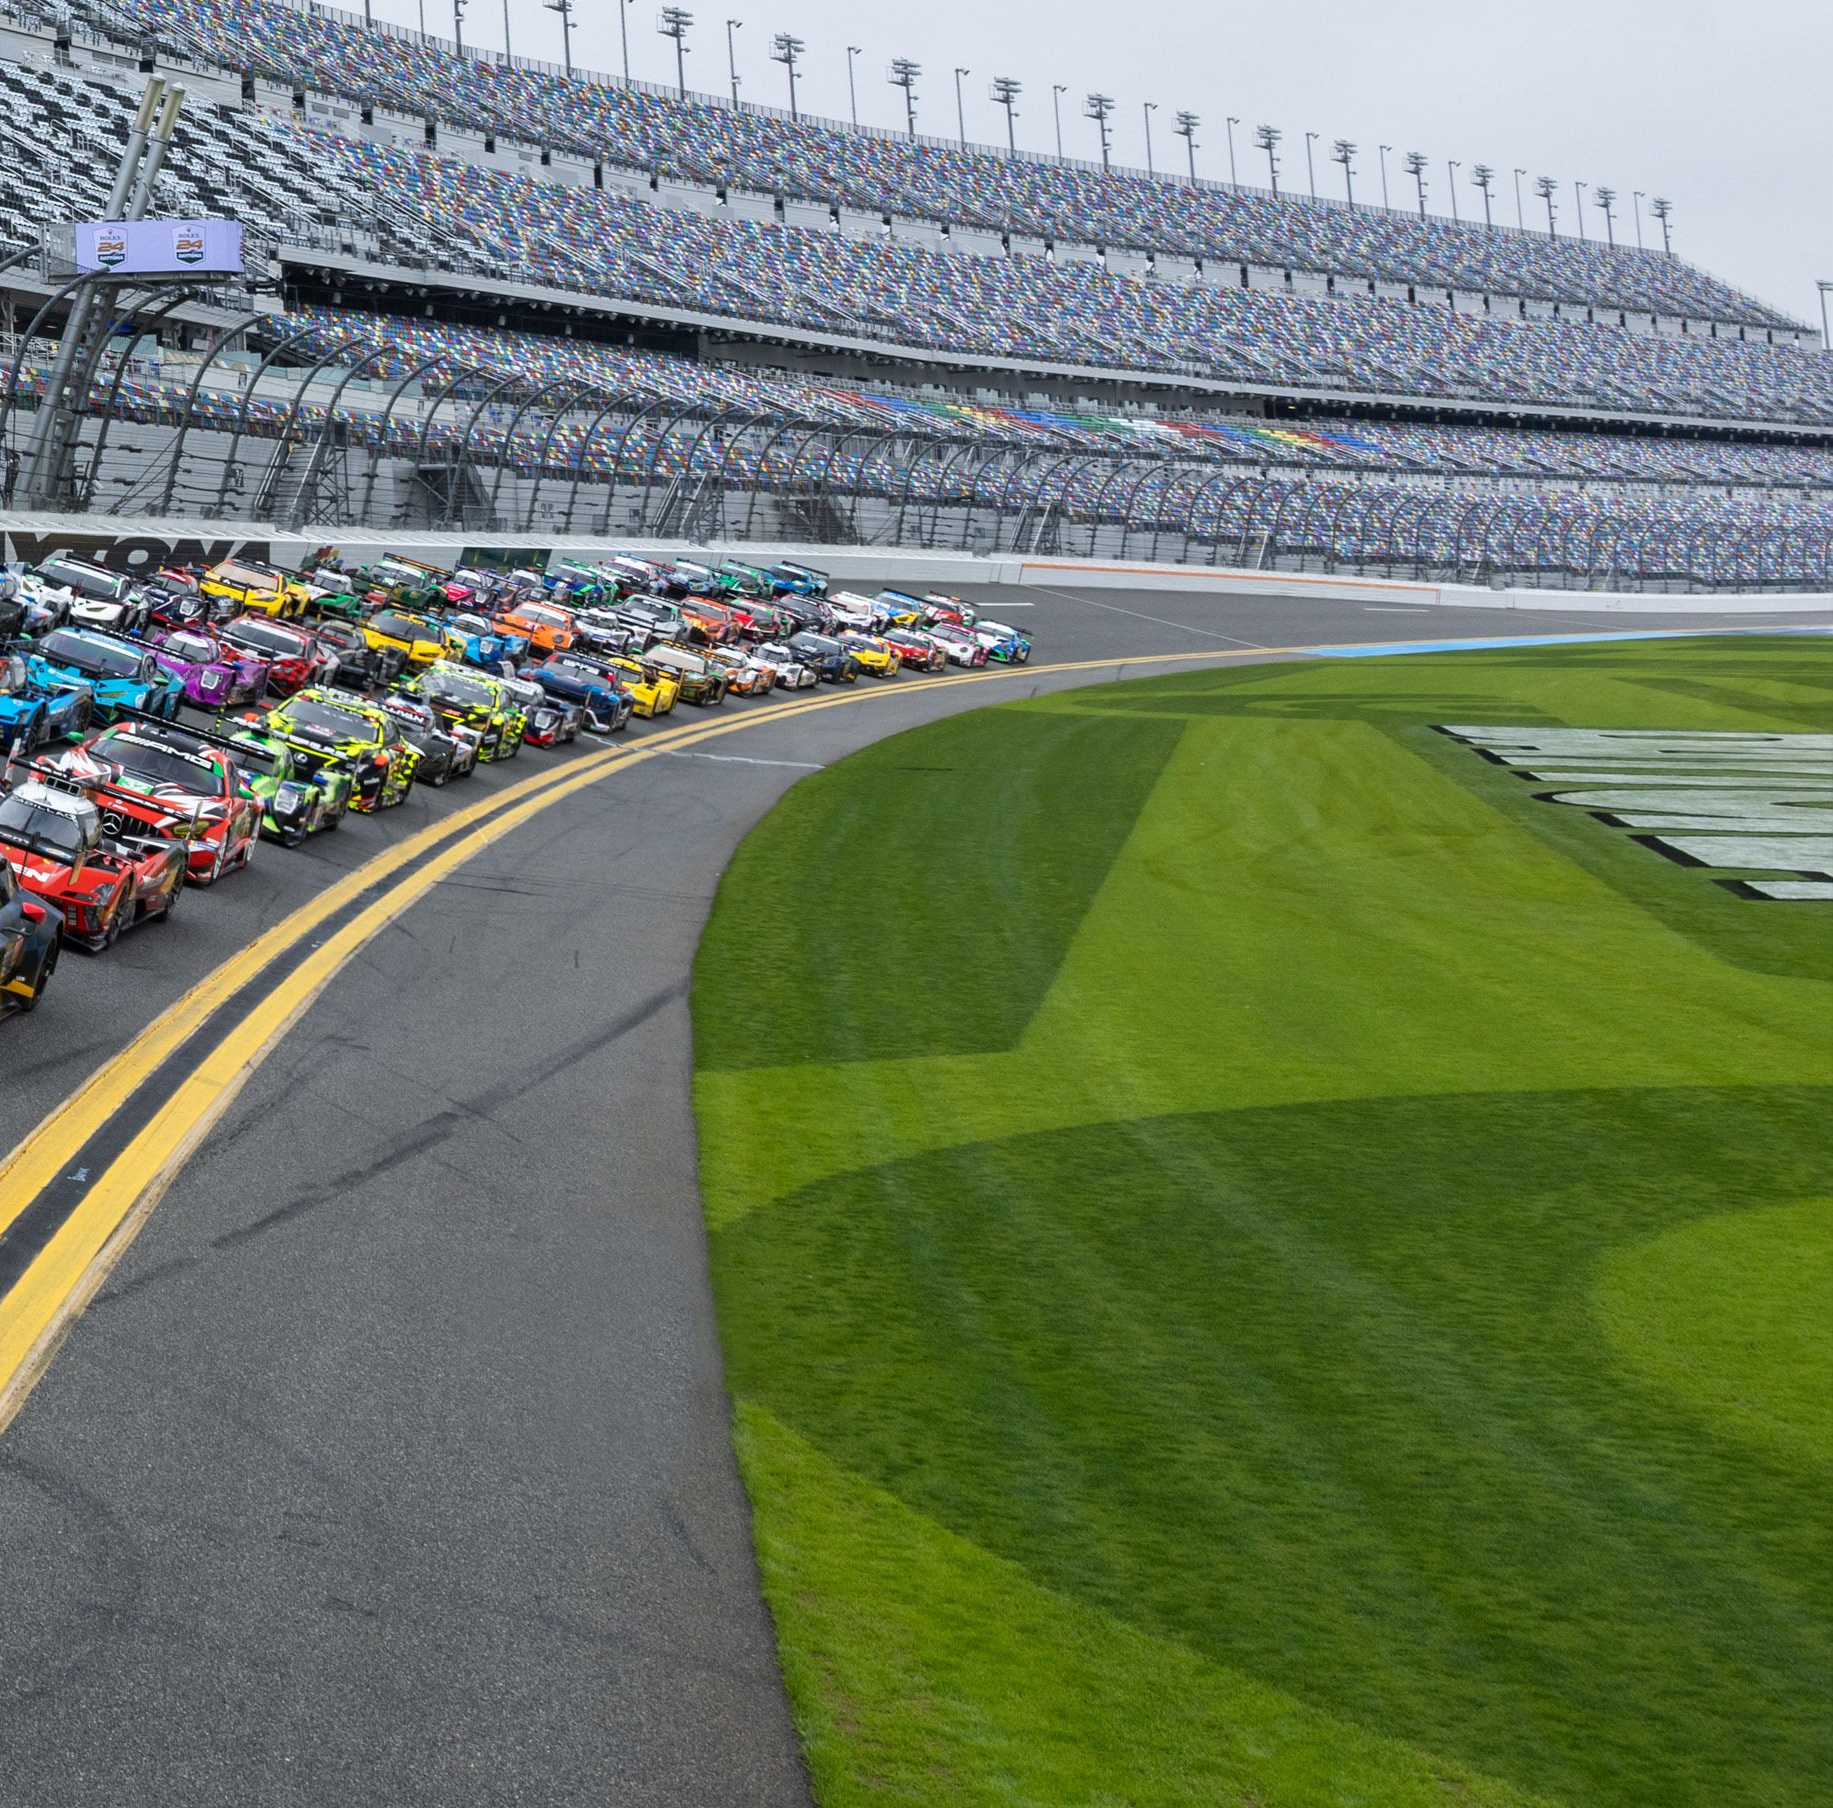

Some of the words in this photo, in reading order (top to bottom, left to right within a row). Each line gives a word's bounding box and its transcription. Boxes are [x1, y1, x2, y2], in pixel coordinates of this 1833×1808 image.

[97, 242, 124, 252] 24
[176, 240, 203, 250] 24
[147, 739, 213, 769] AMG
